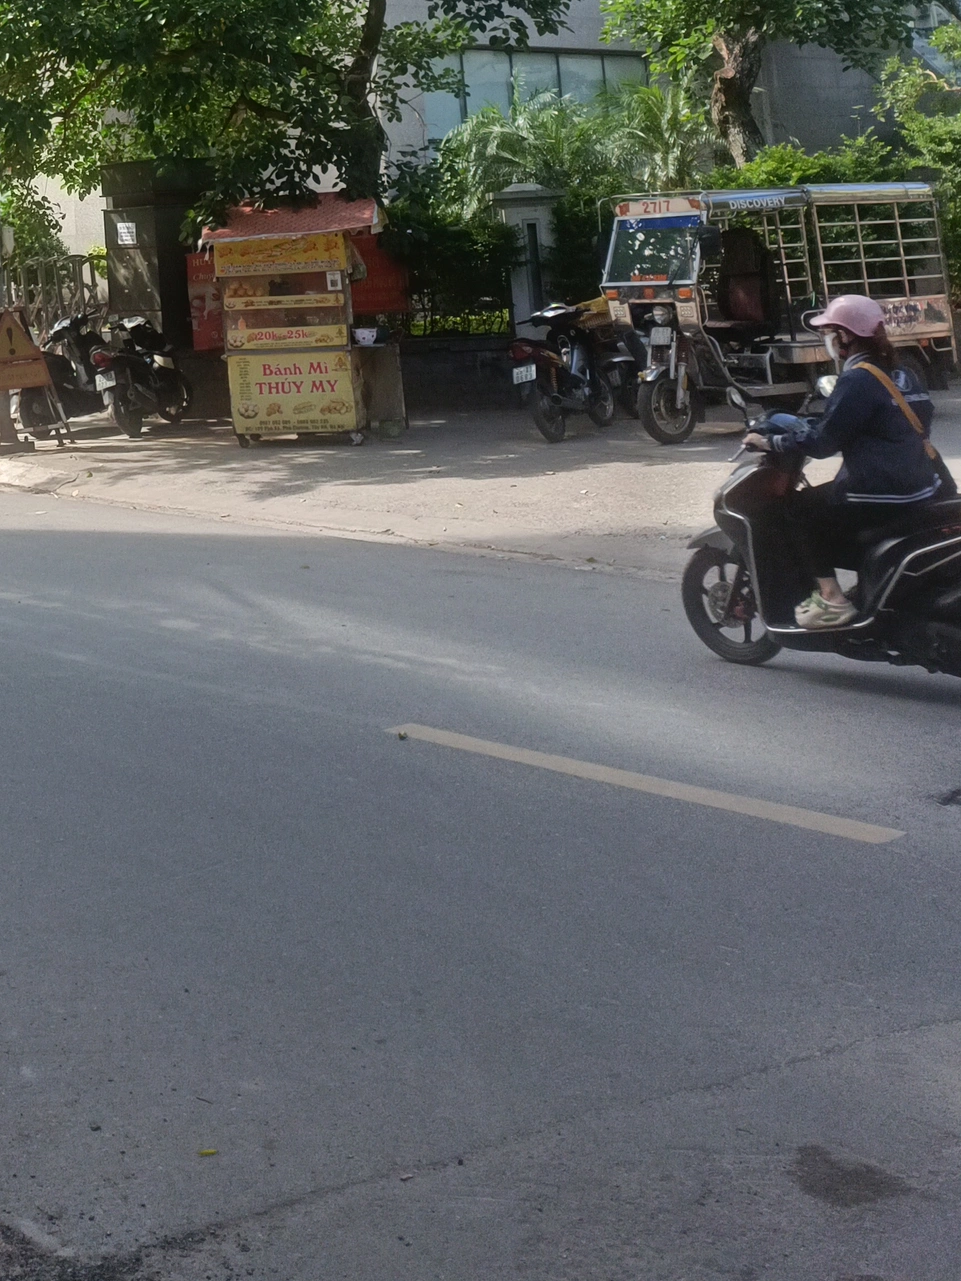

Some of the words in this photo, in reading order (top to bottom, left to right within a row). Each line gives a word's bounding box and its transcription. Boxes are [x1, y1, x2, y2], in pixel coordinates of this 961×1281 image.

[729, 197, 786, 210] DISCOVERY
[262, 363, 303, 376] Bánh
[308, 361, 329, 375] Mì
[255, 378, 304, 395] THÚY
[310, 380, 339, 393] MY
